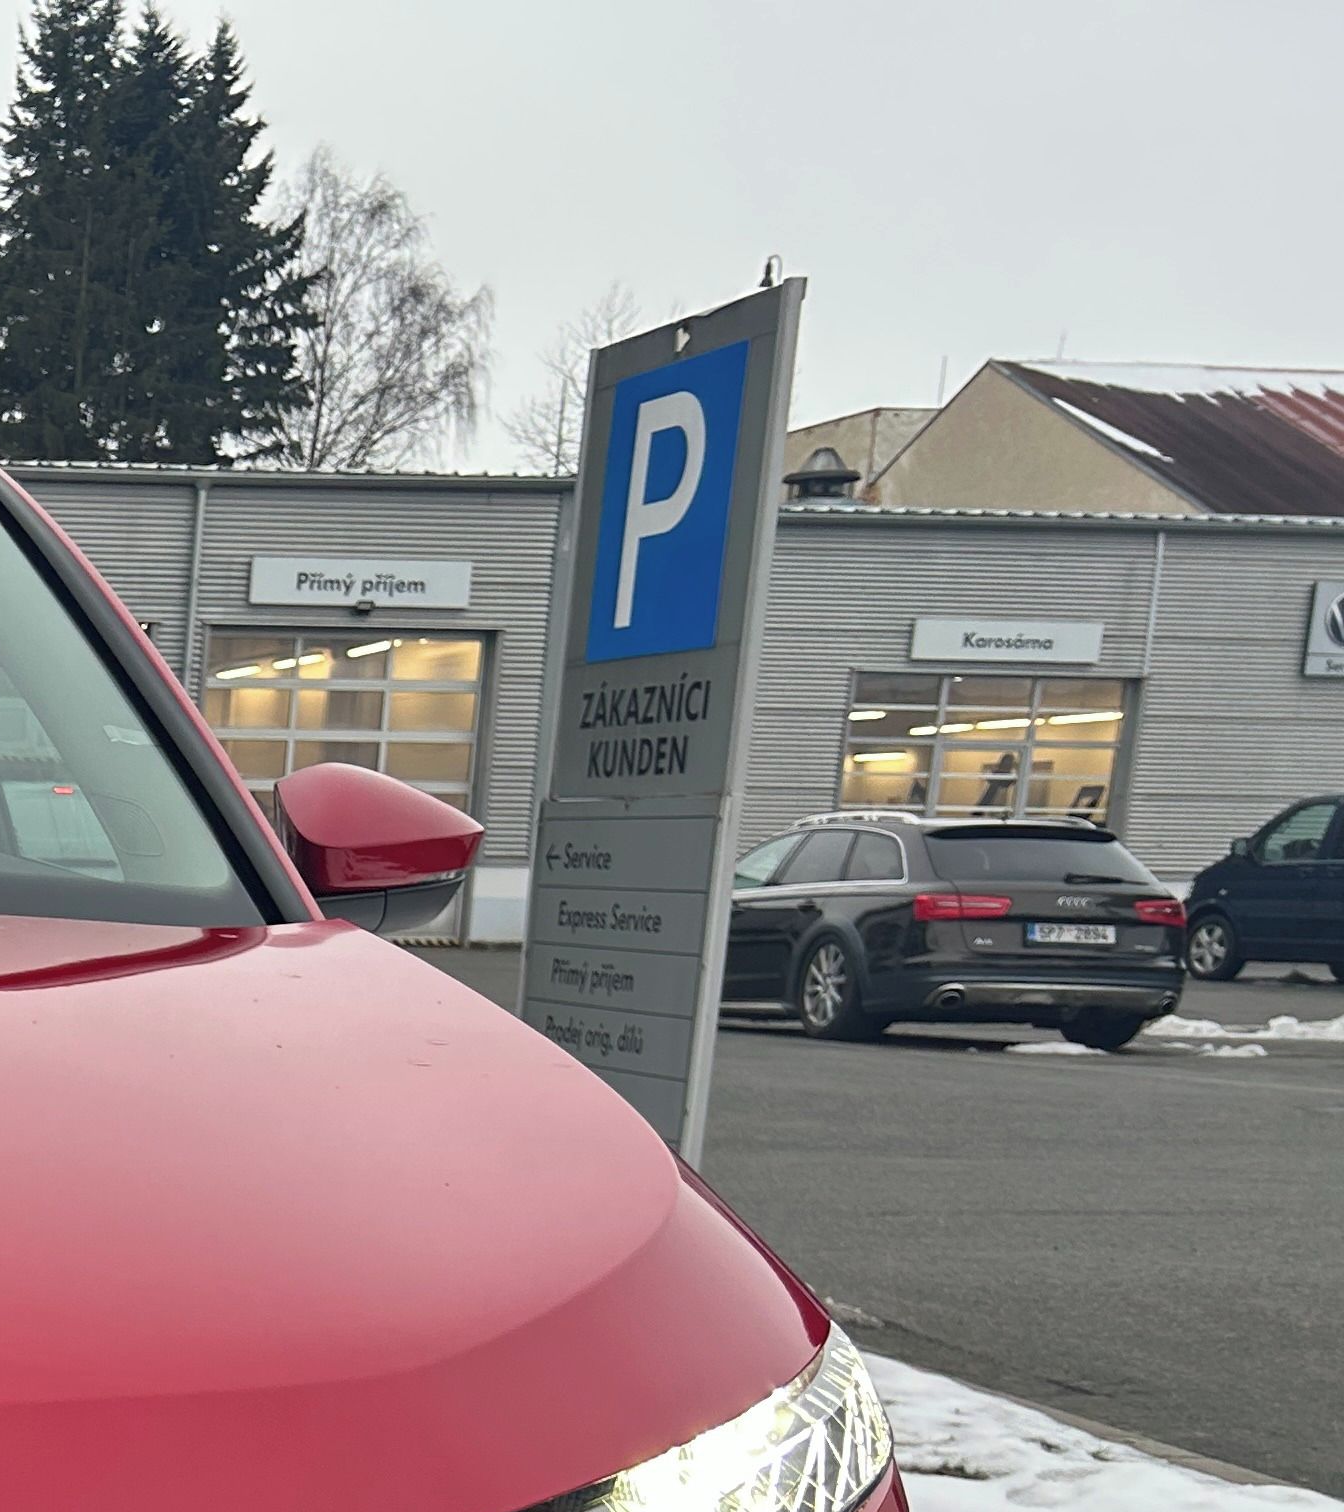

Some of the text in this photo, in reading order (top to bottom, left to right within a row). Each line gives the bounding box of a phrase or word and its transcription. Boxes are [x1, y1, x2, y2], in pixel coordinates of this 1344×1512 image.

[613, 391, 707, 629] P
[296, 571, 427, 597] Přímý příjem
[579, 672, 712, 730] ZÁKAZNÍCI
[587, 735, 690, 779] KUNDEN
[563, 841, 613, 871] Service
[557, 900, 663, 934] Express Service
[550, 957, 635, 997] Přímý příjem
